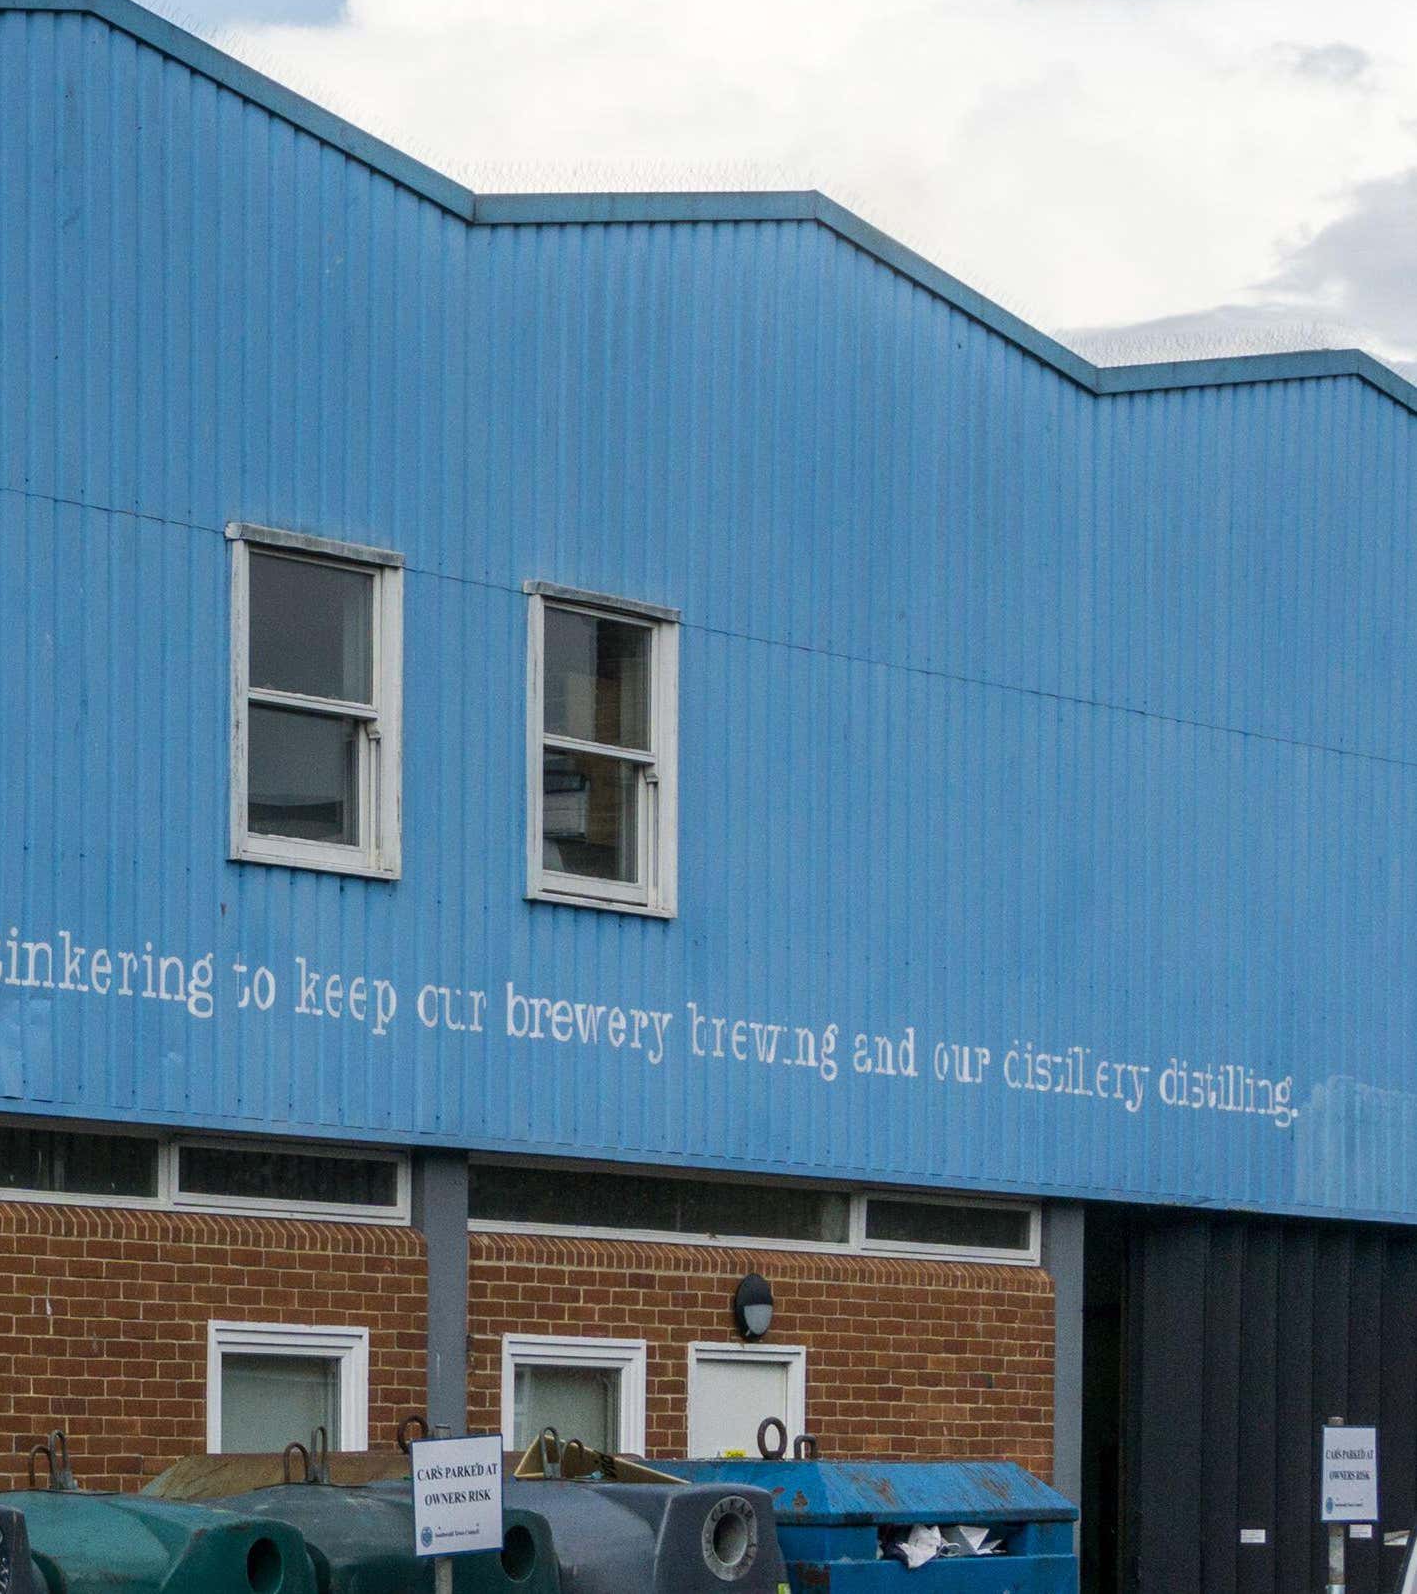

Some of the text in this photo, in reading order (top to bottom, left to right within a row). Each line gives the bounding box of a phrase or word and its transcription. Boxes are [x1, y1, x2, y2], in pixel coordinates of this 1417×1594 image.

[233, 954, 276, 1011] to
[294, 956, 398, 1036] keep
[417, 983, 487, 1032] our
[506, 981, 673, 1065] brewery
[852, 1026, 919, 1078] and
[933, 1041, 991, 1084] our
[485, 1463, 498, 1476] AT
[424, 1489, 492, 1506] OWNERS RISK
